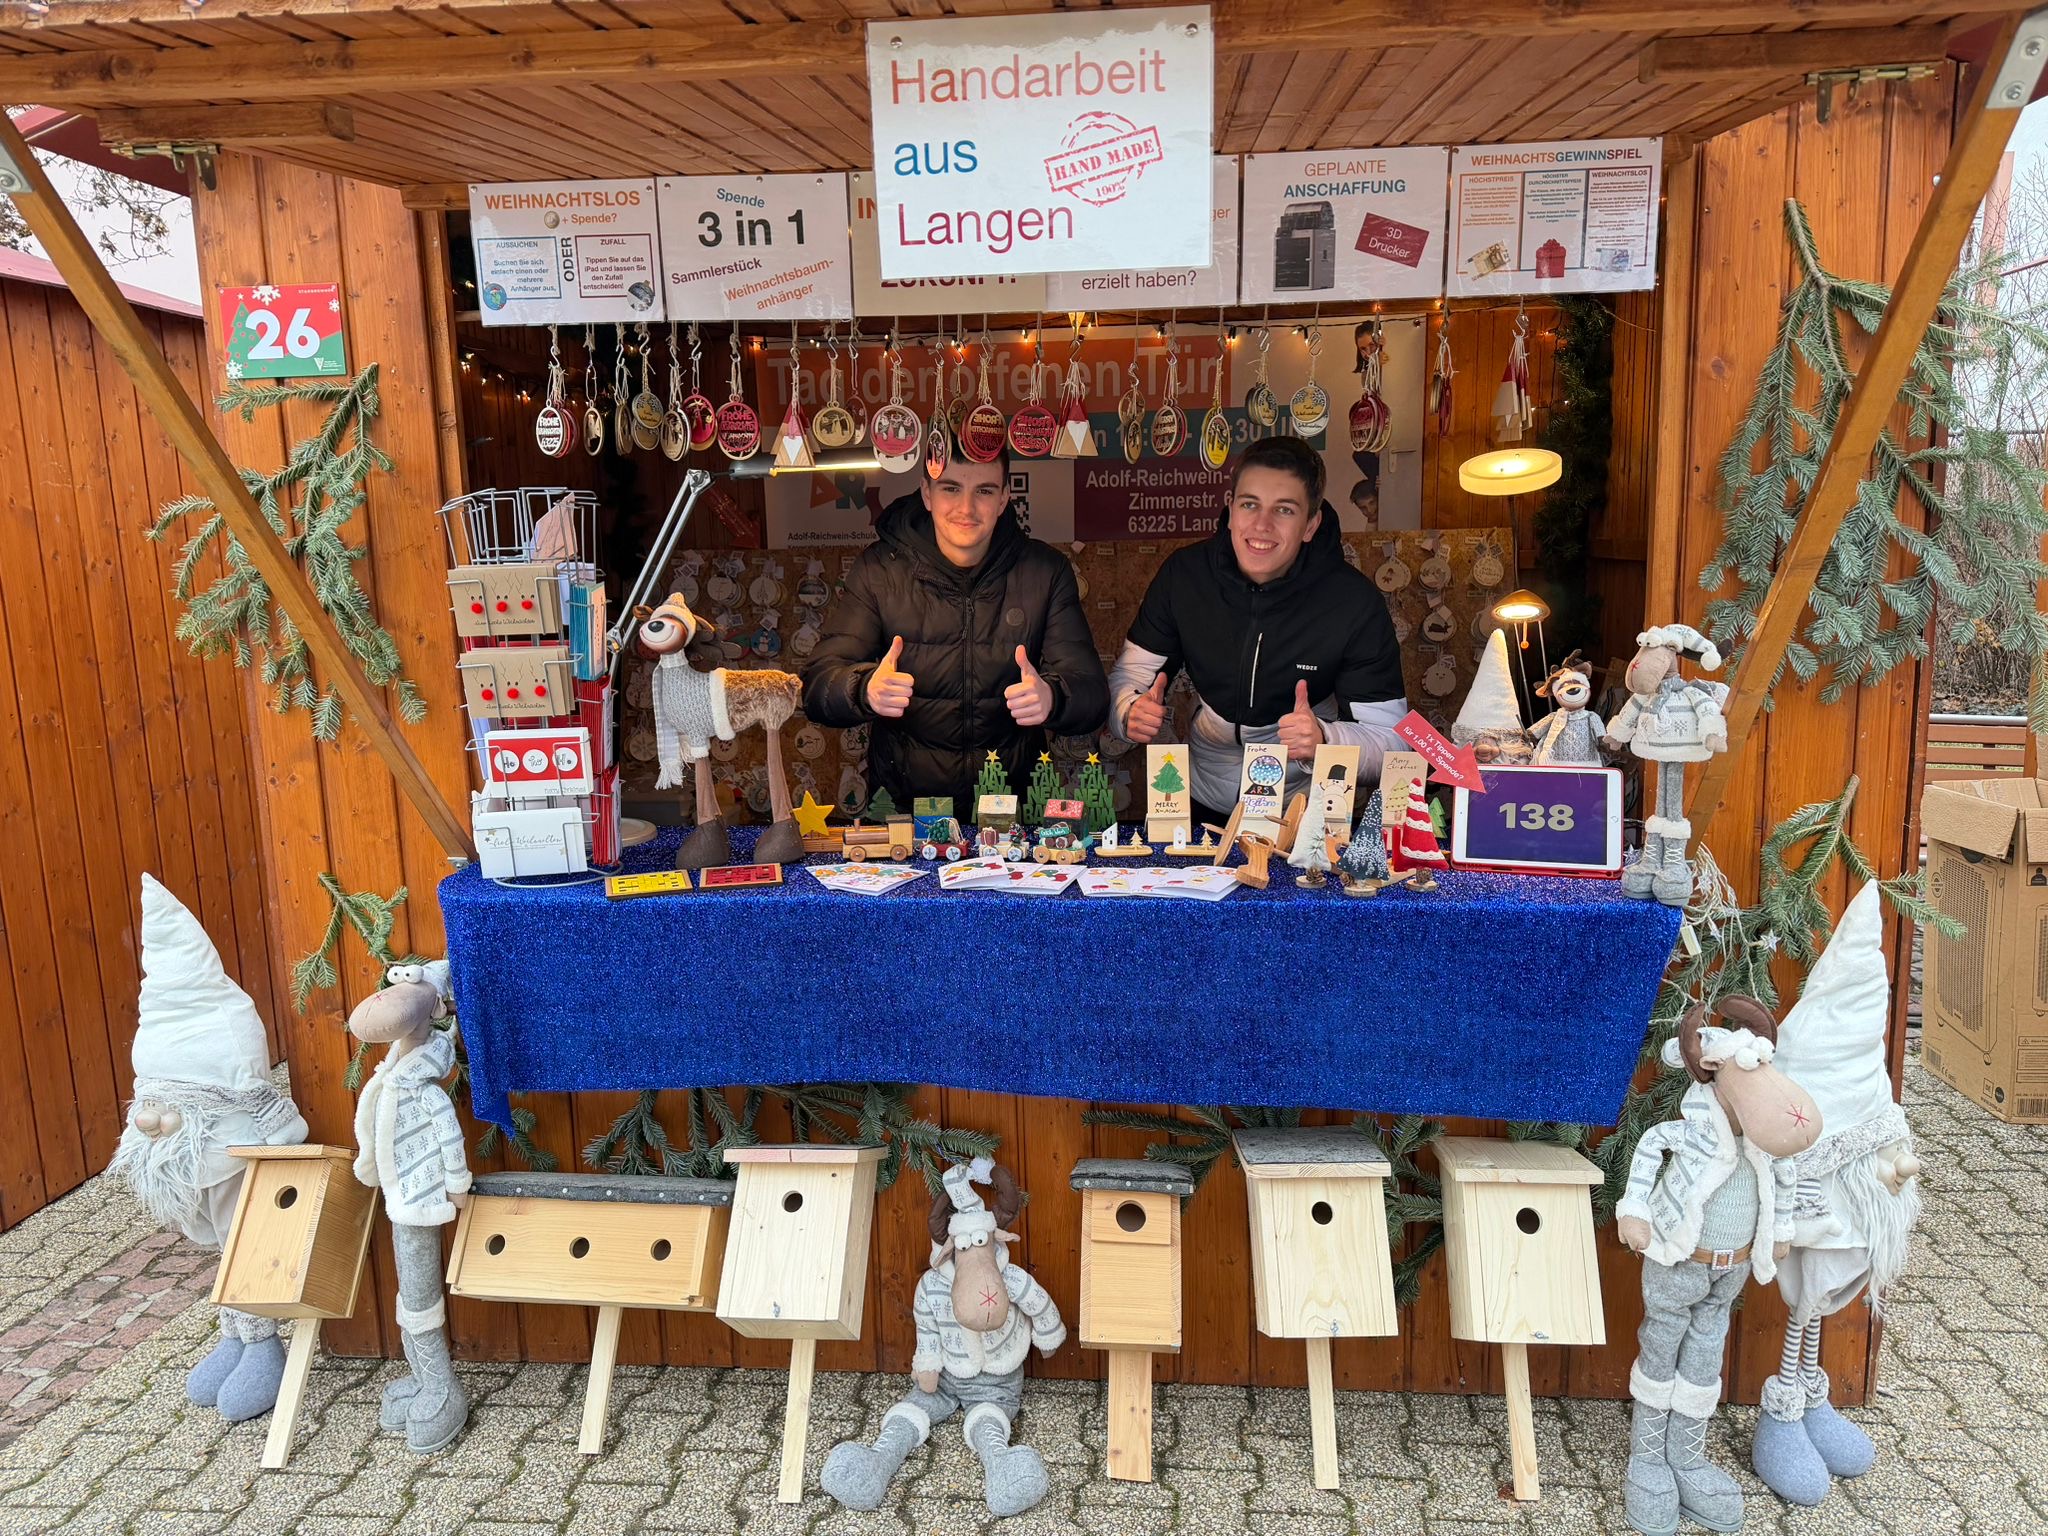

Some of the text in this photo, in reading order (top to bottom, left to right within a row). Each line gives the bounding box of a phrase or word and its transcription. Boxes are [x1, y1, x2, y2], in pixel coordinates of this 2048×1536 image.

[890, 48, 1166, 104] Handarbeit
[894, 139, 978, 176] aus
[1053, 138, 1155, 182] HAND MADE
[1471, 148, 1643, 167] WEIHNACHTSGEWINNSPIEL
[1304, 159, 1387, 177] GEPLANTE
[1591, 170, 1648, 178] WEIHNACHTSLOS
[1095, 180, 1126, 198] 100%
[1284, 179, 1406, 199] ANSCHAFFUNG
[1469, 175, 1515, 184] HÖCHSTPREIS
[484, 190, 640, 210] WEIHNACHTSLOS
[716, 188, 765, 209] Spende
[571, 212, 618, 225] Spende?
[698, 209, 805, 248] 3 in 1
[898, 202, 1073, 254] Langen
[1386, 227, 1402, 240] 3D
[496, 241, 539, 249] AUSSUCHEN
[1368, 237, 1410, 259] Drucker
[560, 237, 575, 282] ODER
[671, 257, 763, 285] Sammlerstück
[723, 258, 835, 303] Weihnachtsbaum-
[1081, 267, 1198, 291] erzielt haben?
[510, 285, 542, 294] Anhänger
[757, 282, 814, 311] anhänger
[245, 308, 320, 360] 26
[1136, 343, 1218, 397] Tür
[1129, 491, 1219, 511] Zimmerstr.
[1127, 515, 1177, 534] 63225
[788, 531, 877, 540] Adolf-Reichwein-Schule
[1247, 745, 1268, 753] Frohe
[1403, 726, 1413, 736] für
[1412, 734, 1427, 749] 1,00
[1435, 755, 1464, 780] Spende?
[1426, 733, 1456, 762] 1x Tippen
[1034, 762, 1054, 773] OH
[1082, 764, 1102, 775] OH
[1030, 772, 1061, 787] TAN
[1078, 773, 1109, 789] TAN
[1026, 785, 1066, 804] NEN
[1073, 788, 1114, 809] NEN
[1249, 786, 1270, 795] ARS
[1499, 802, 1575, 831] 138
